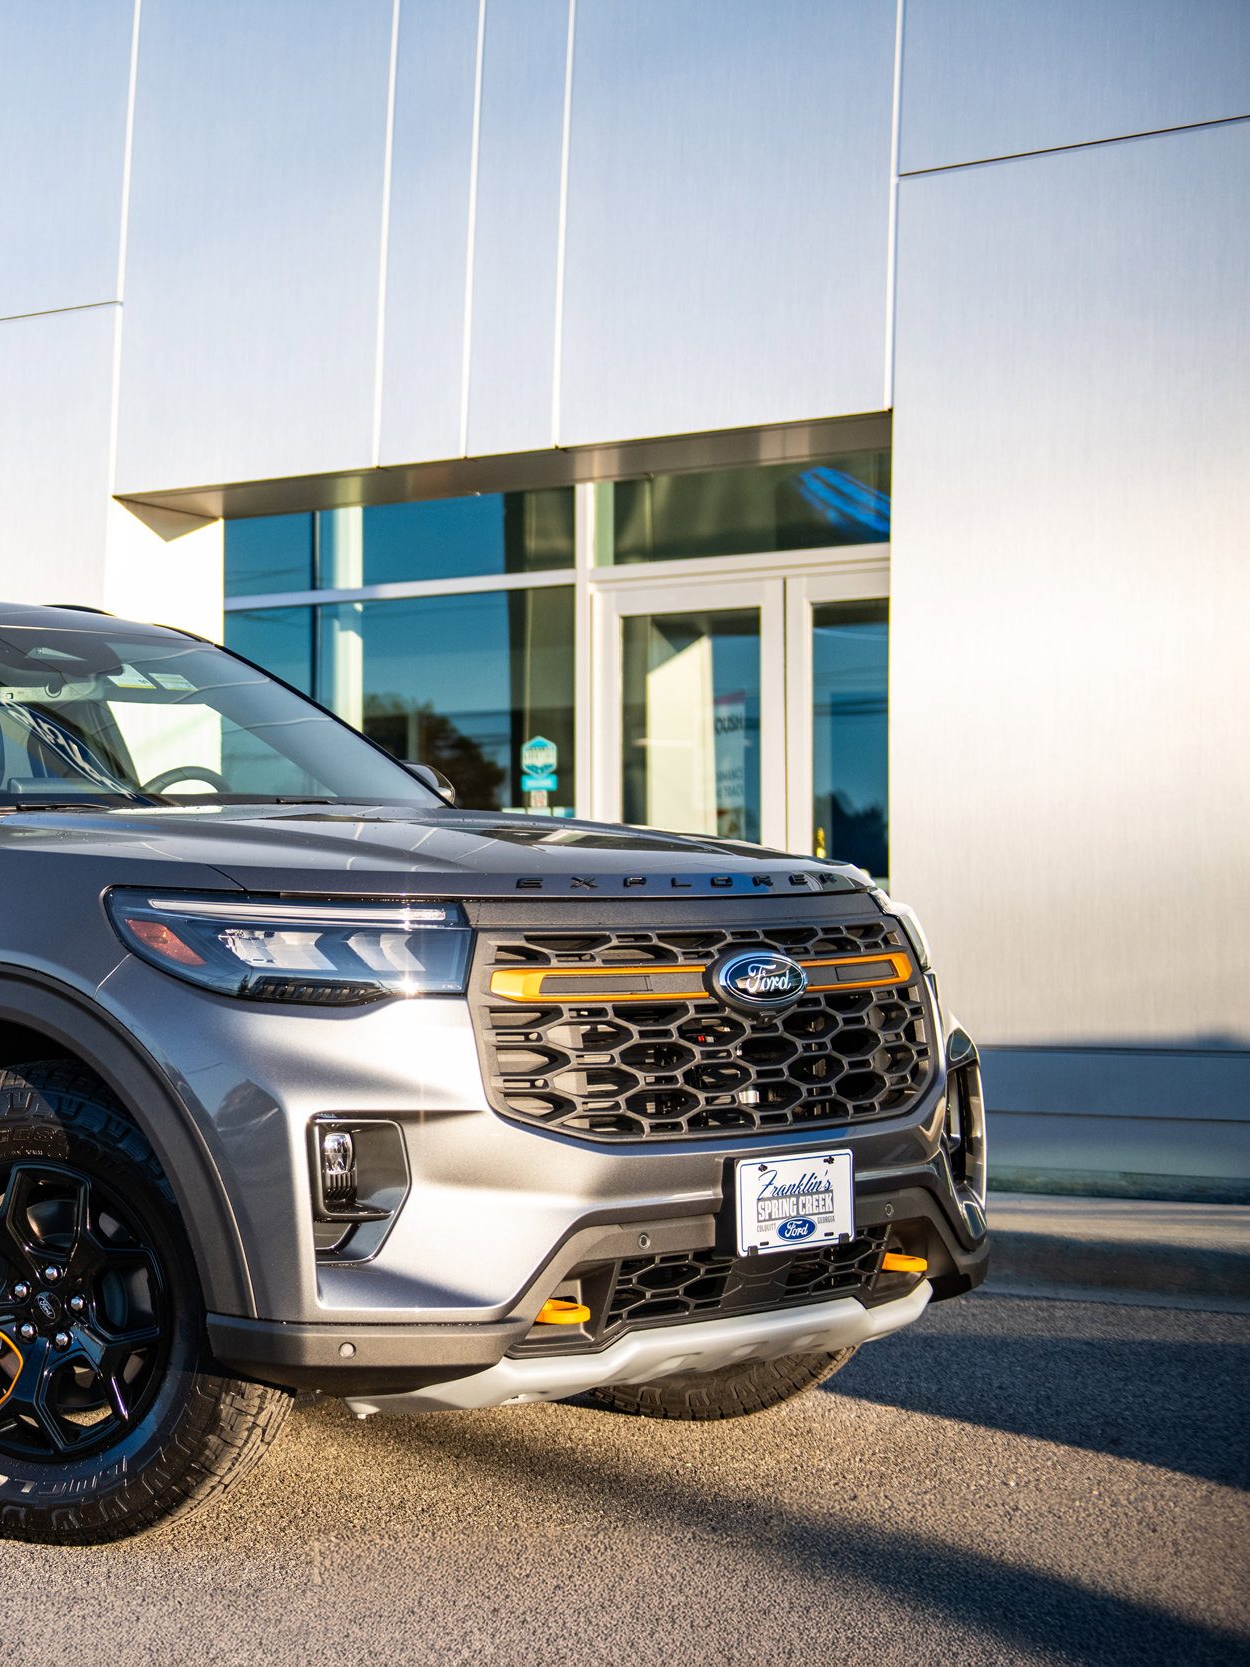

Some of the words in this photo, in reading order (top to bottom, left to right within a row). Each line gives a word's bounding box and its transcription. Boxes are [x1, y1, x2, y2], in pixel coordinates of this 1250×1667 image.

[715, 713, 746, 735] OUSH
[515, 872, 838, 890] EXPLORER
[746, 963, 791, 993] Ford
[757, 1169, 833, 1200] Franklin's
[758, 1197, 797, 1221] SPRING
[798, 1192, 834, 1216] CREEK
[784, 1220, 809, 1237] Ford
